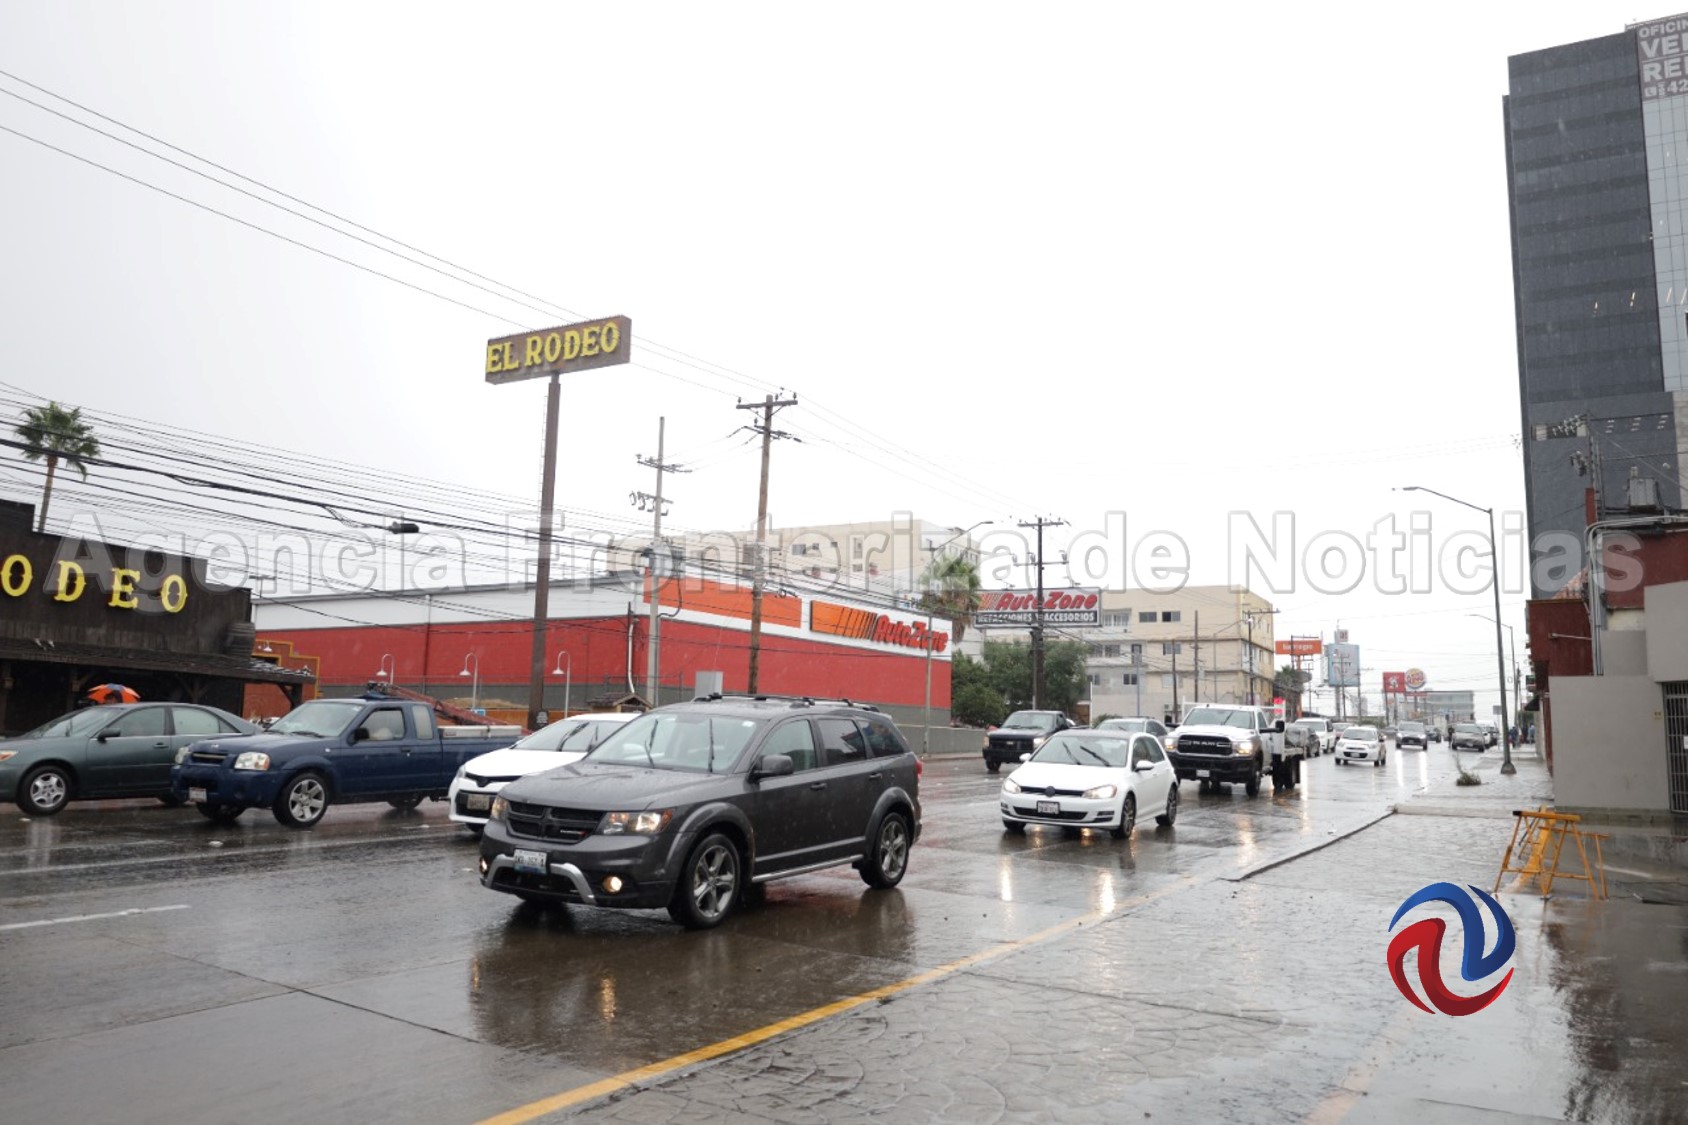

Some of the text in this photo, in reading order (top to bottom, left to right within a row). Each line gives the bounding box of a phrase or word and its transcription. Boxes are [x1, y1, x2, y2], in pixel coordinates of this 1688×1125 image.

[486, 321, 620, 373] EL RODEO
[1, 554, 187, 613] ODEO
[873, 614, 949, 653] AutoZone
[1044, 612, 1095, 622] ACCESORIOS
